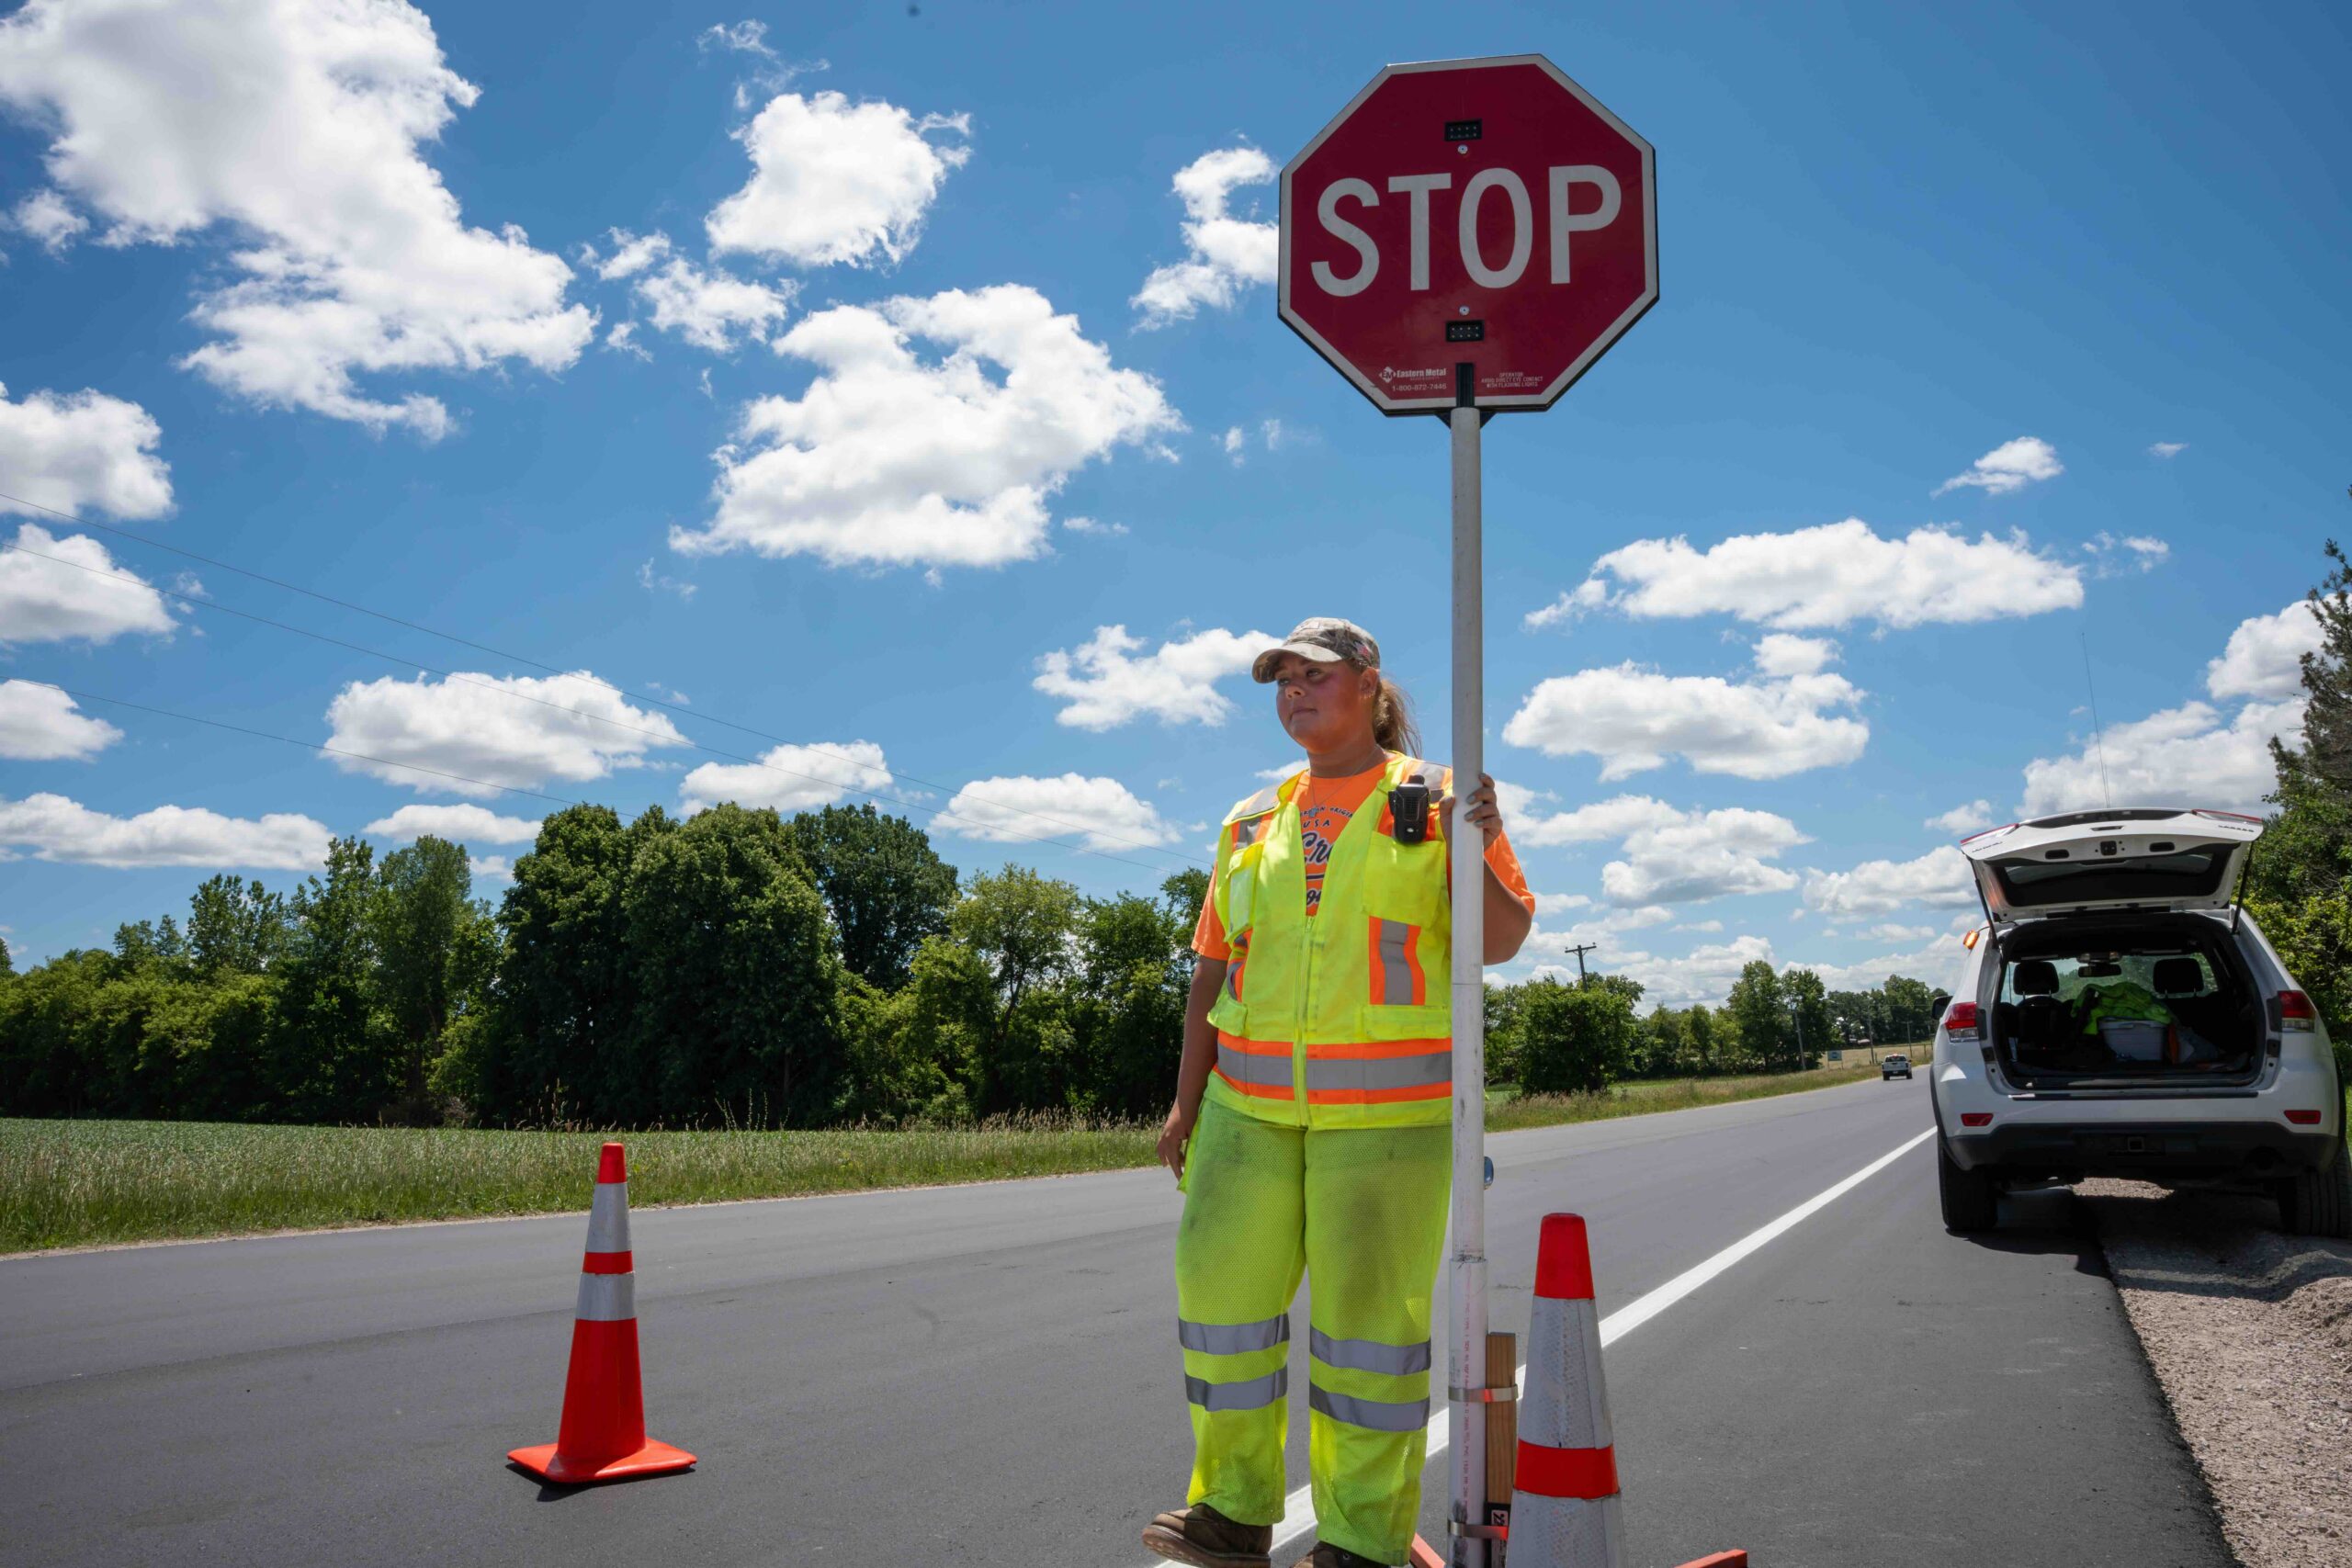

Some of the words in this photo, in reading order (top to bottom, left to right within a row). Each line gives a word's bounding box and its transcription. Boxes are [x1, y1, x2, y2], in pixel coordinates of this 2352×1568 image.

[1310, 164, 1623, 298] STOP
[1396, 369, 1424, 378] Eastern
[1425, 367, 1447, 377] Metal
